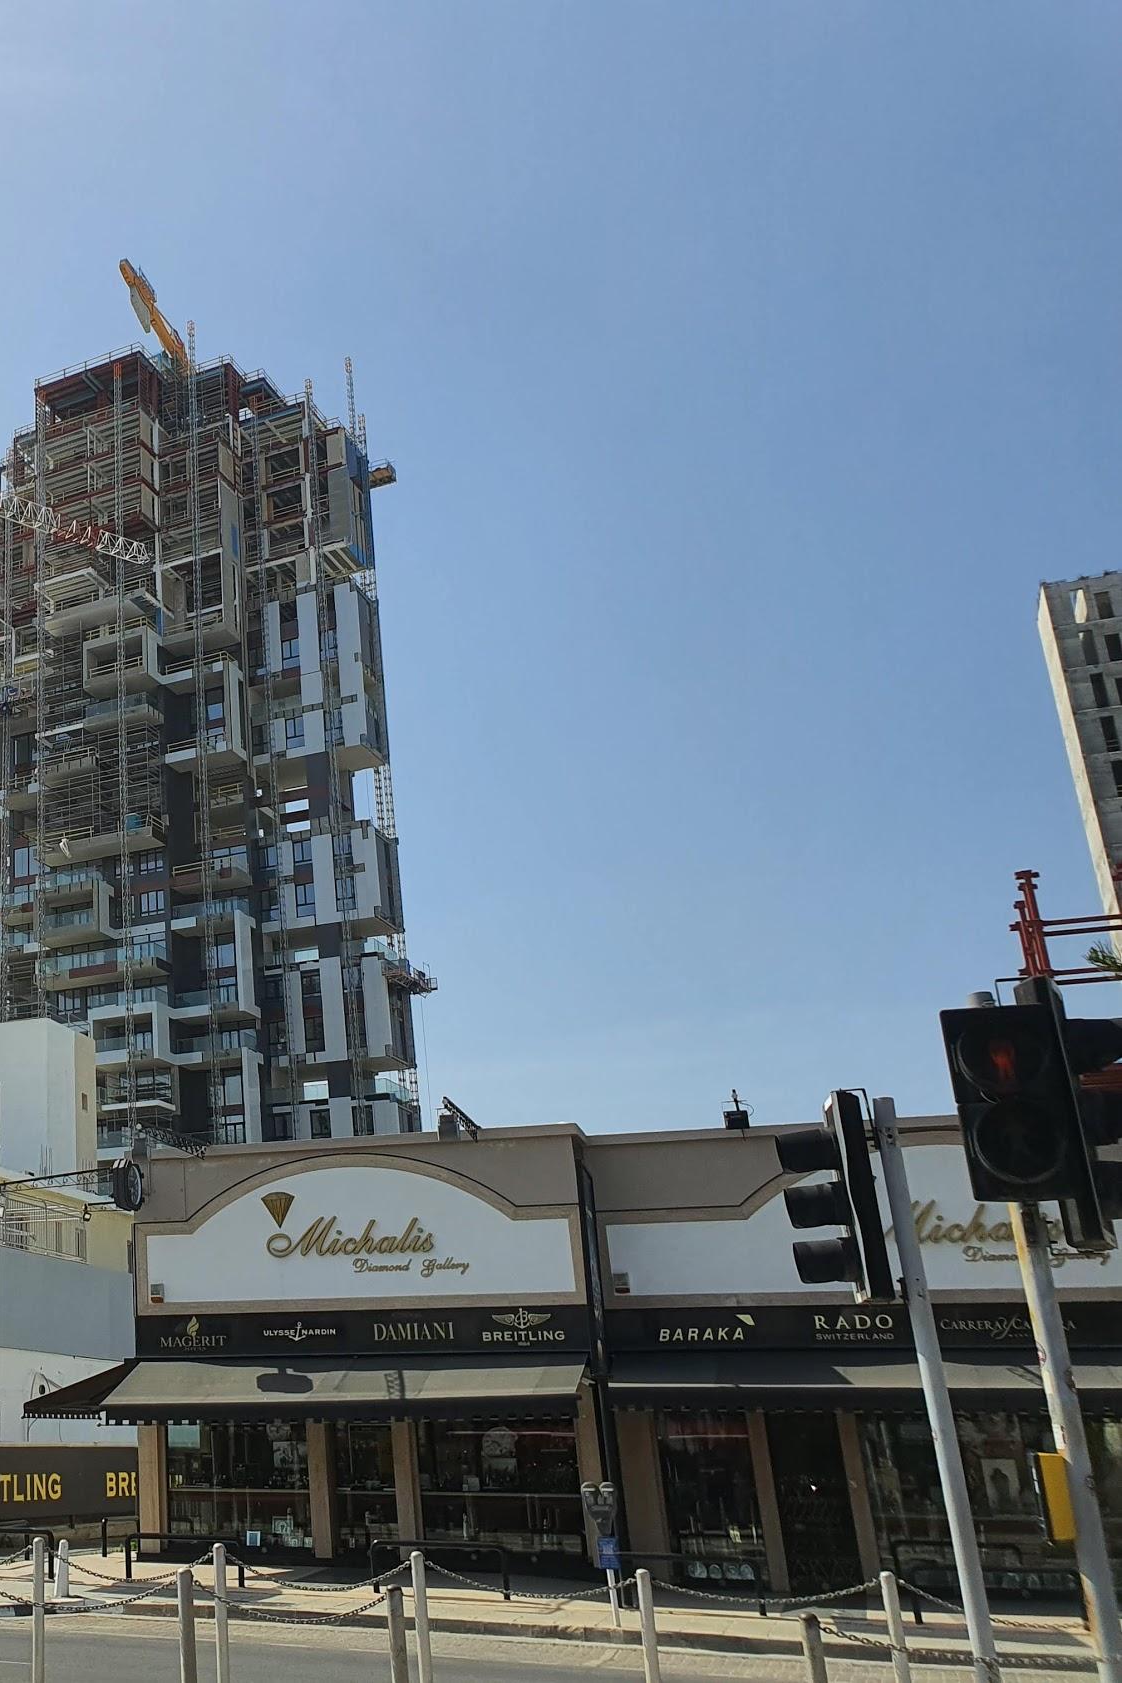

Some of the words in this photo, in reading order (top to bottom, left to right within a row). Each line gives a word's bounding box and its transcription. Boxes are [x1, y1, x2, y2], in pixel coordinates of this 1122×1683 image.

[266, 1216, 435, 1258] Michalis
[352, 1258, 412, 1273] Diamond
[421, 1257, 469, 1278] Gallery
[813, 1314, 893, 1329] RADO
[263, 1328, 295, 1337] ULYSSE
[301, 1328, 336, 1336] NARDIN
[373, 1321, 454, 1341] DAMIANI
[482, 1330, 565, 1342] BREITLING
[659, 1327, 744, 1342] BARAKA
[815, 1332, 895, 1340] SWITZERLAND
[160, 1336, 227, 1348] MAGERIT
